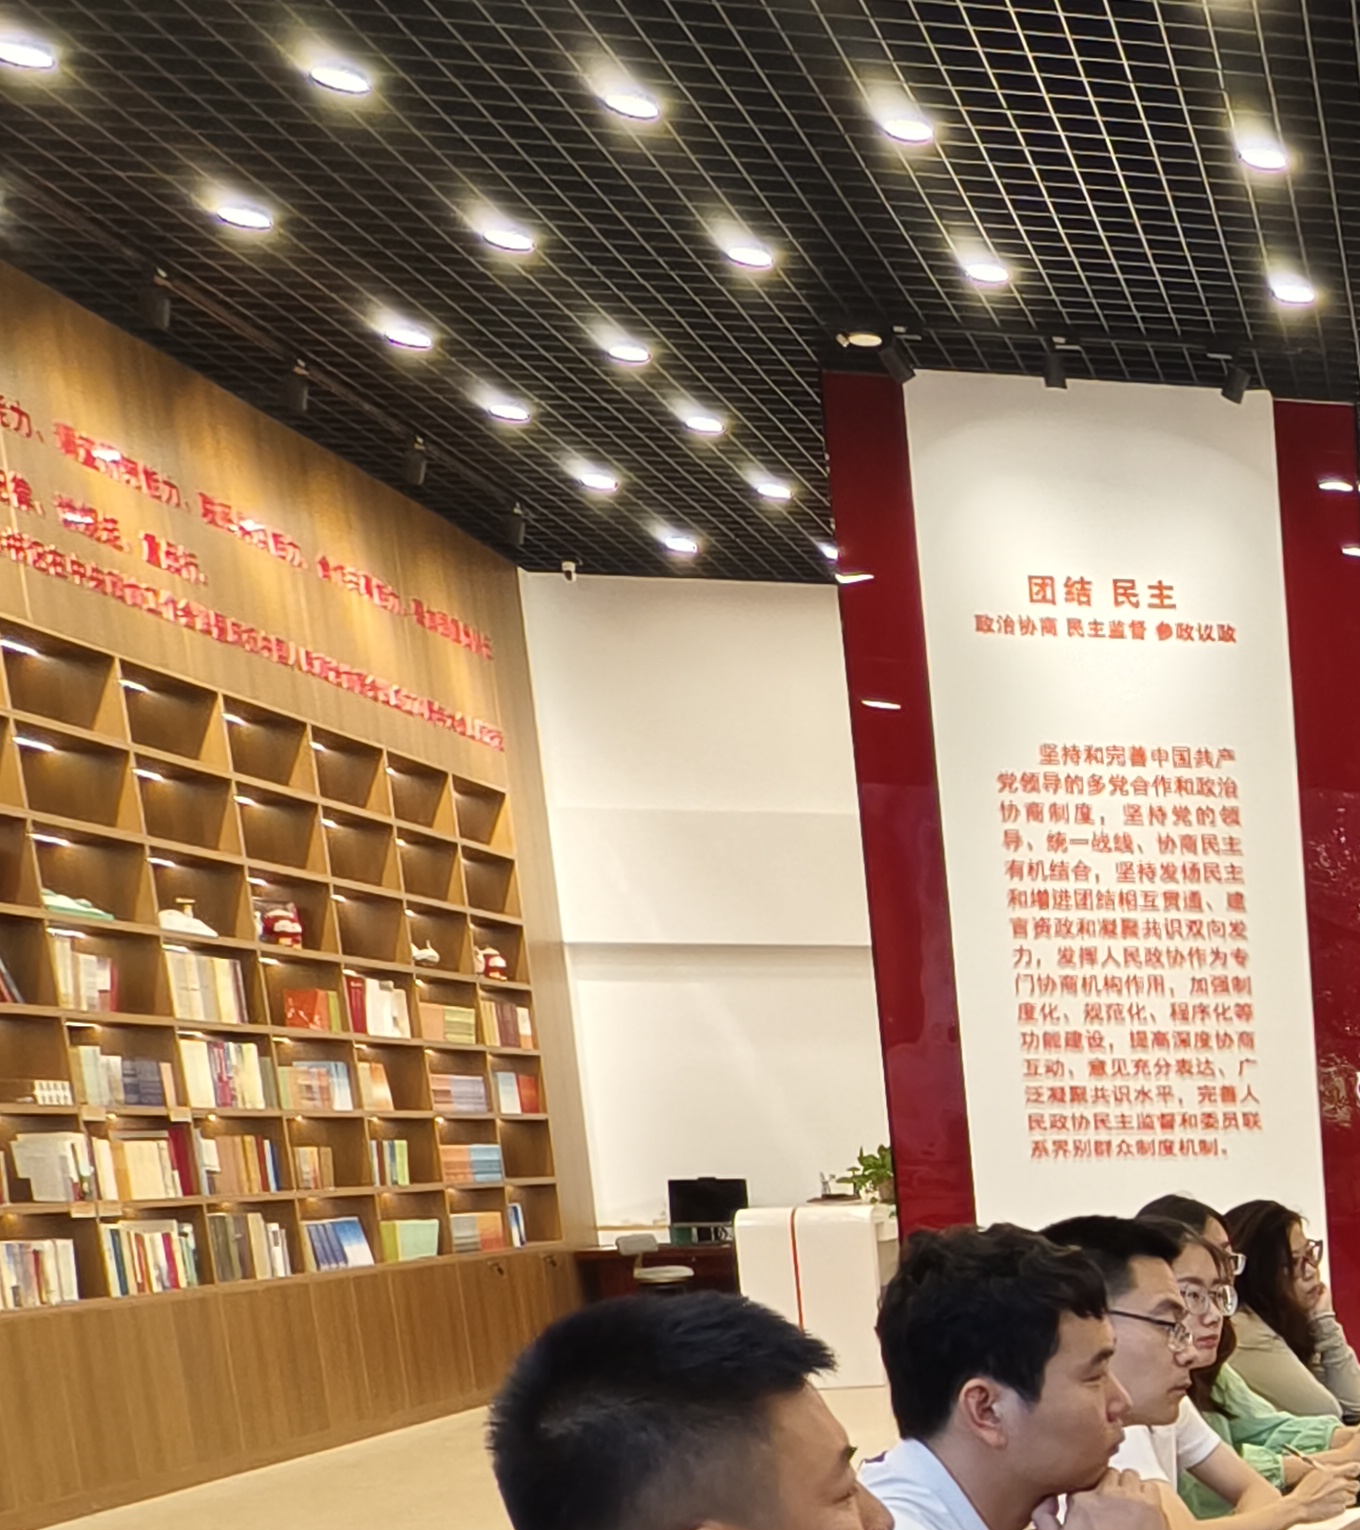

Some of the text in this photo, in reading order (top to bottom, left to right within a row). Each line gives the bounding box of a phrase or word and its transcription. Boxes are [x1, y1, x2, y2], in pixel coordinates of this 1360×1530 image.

[1027, 575, 1177, 610] 团结 民主
[974, 613, 1237, 643] 政治协商 民主监督 参政议政
